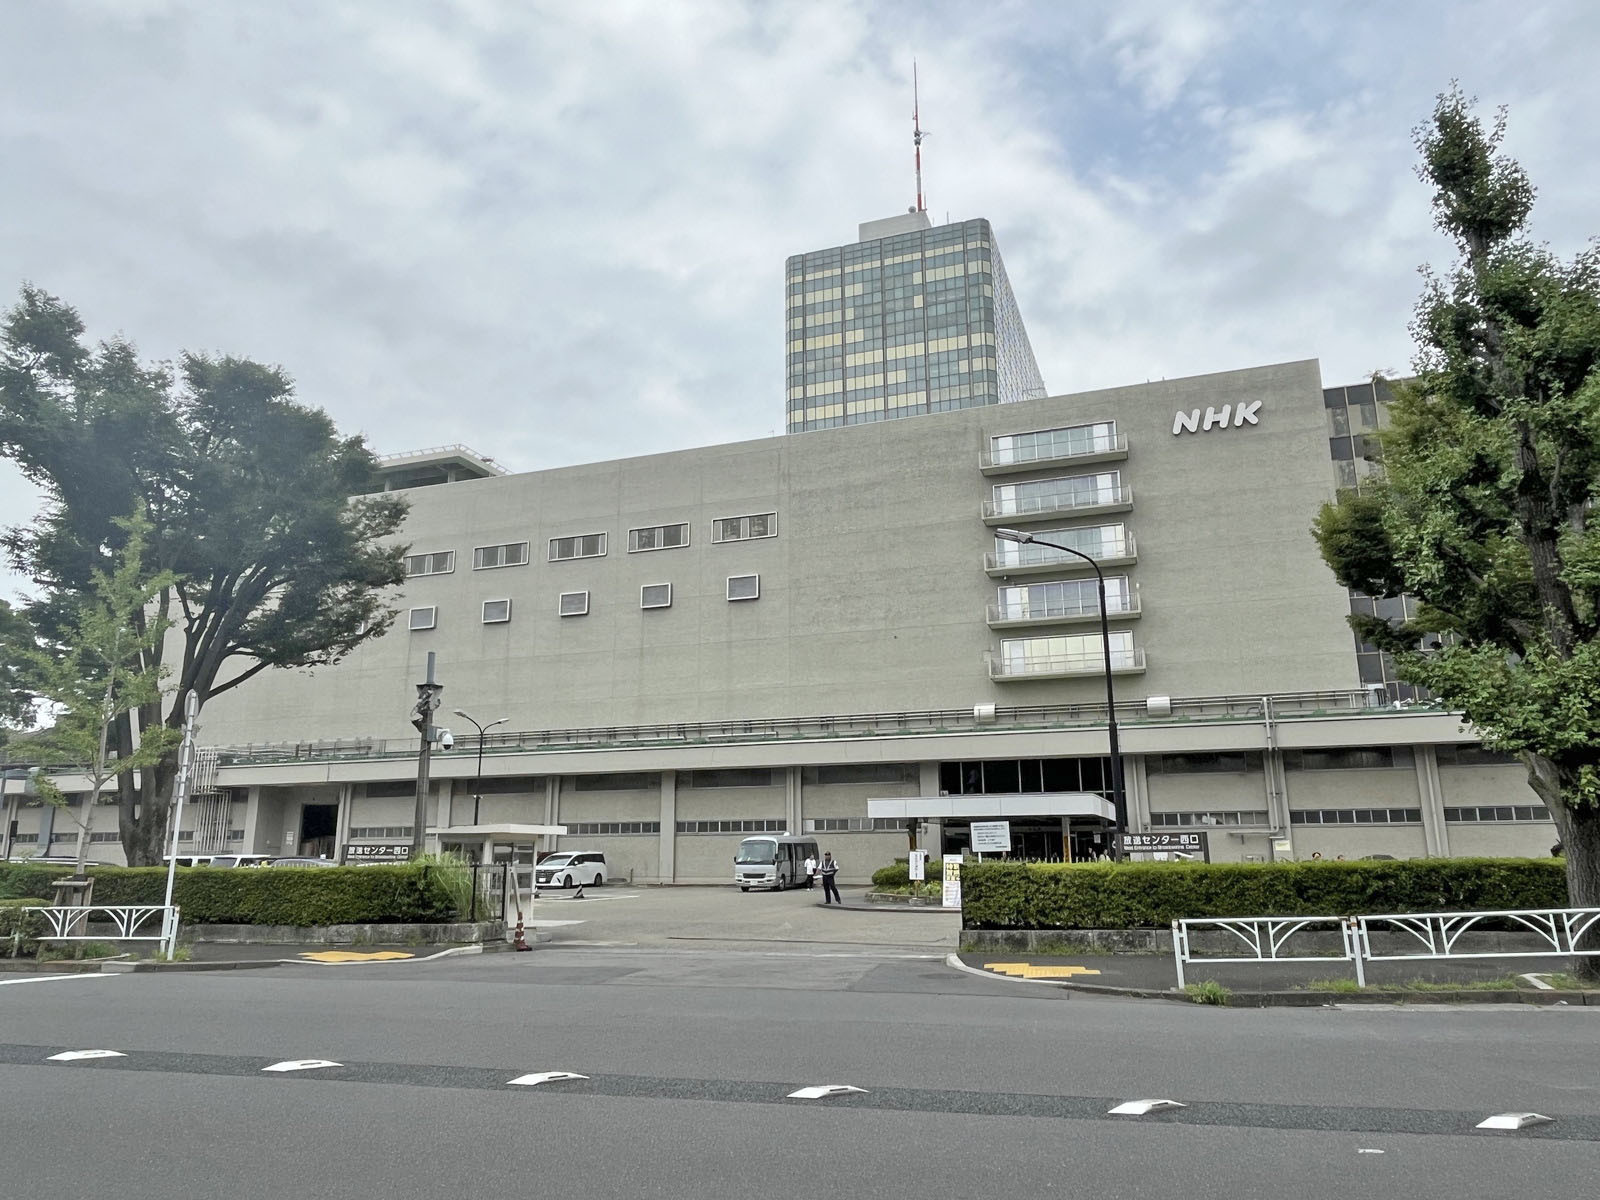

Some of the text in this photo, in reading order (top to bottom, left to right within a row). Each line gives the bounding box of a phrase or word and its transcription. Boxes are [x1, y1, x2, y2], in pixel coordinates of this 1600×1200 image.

[1172, 400, 1262, 435] NHK
[1123, 834, 1199, 845] 放送センター西口
